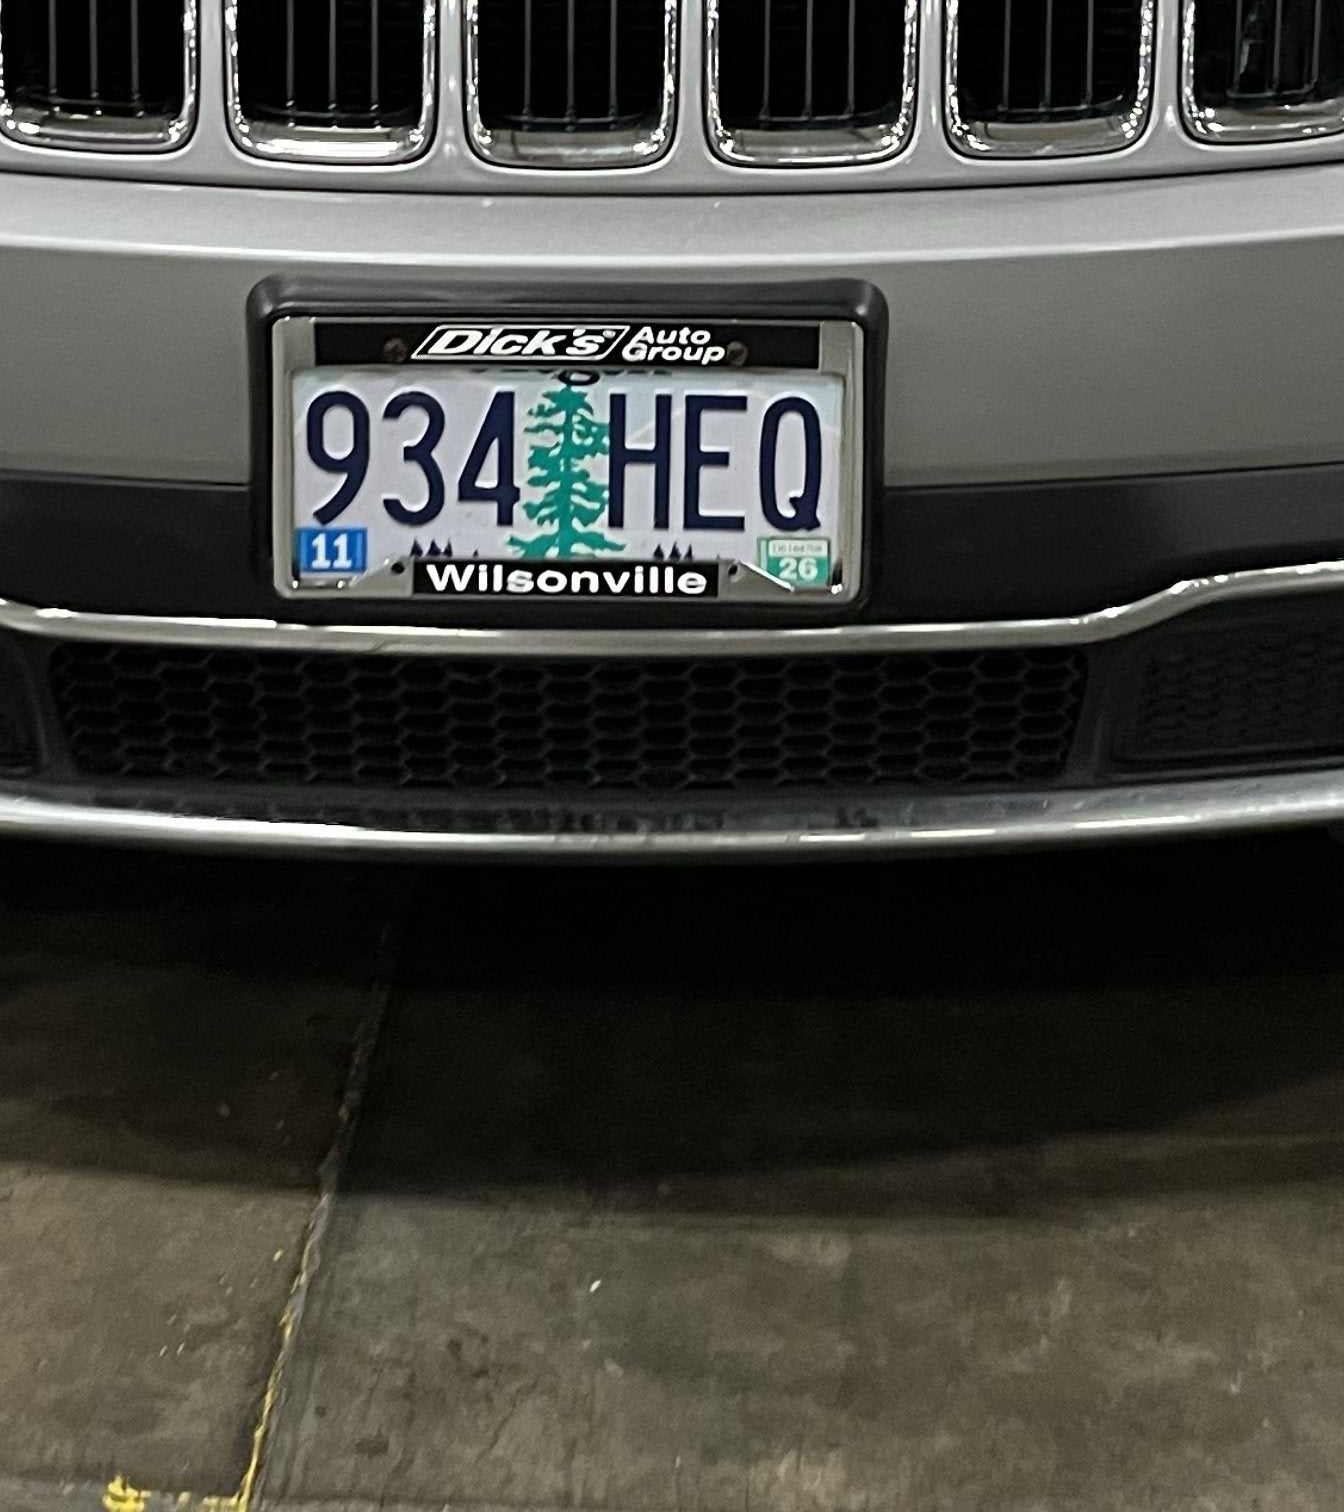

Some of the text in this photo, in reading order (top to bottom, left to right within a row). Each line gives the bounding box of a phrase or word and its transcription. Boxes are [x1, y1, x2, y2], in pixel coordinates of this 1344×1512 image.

[633, 326, 711, 345] Auto
[621, 342, 726, 365] Group
[310, 533, 354, 569] 11
[425, 563, 708, 595] Wilsonville
[778, 556, 818, 581] 26
